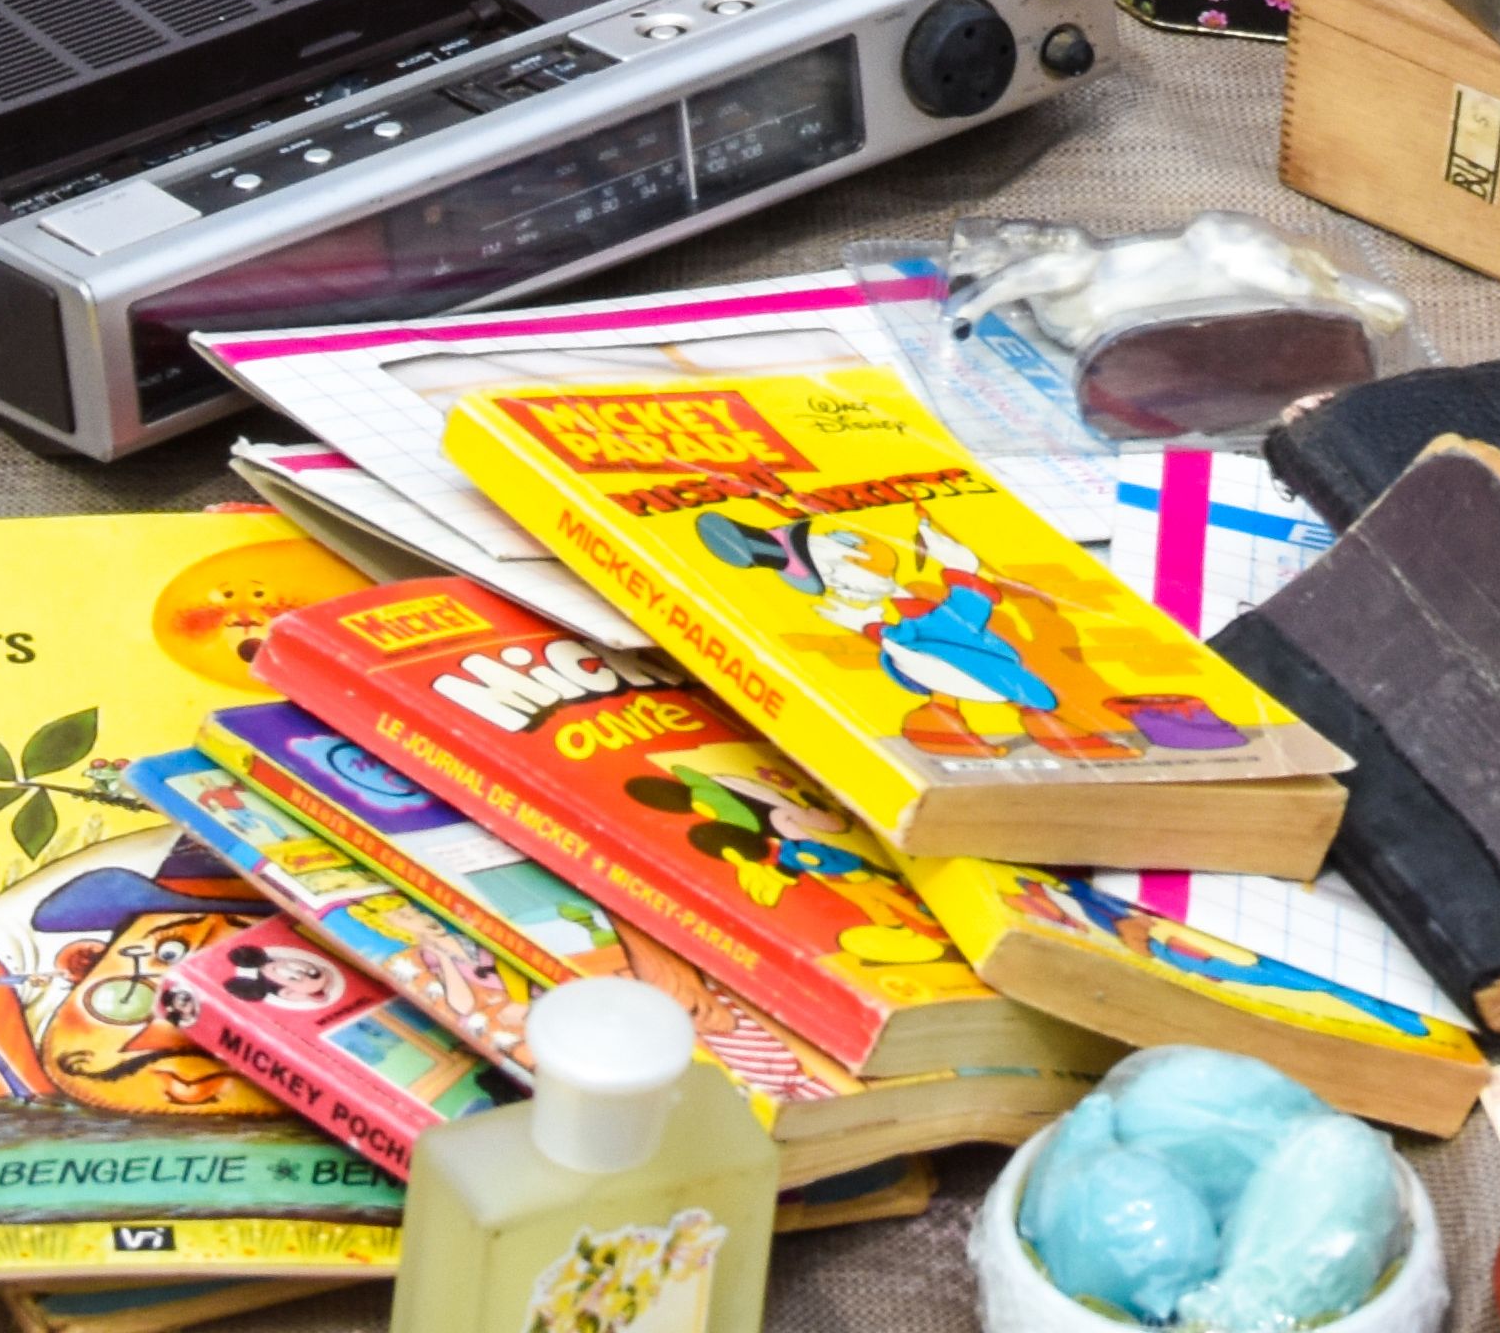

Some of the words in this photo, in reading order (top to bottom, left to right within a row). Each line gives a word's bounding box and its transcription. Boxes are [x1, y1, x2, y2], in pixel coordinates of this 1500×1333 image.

[526, 396, 736, 433] MICKEY
[561, 428, 786, 465] PARADE
[555, 695, 706, 761] ouvre
[402, 731, 486, 796] JOURNAL
[487, 783, 517, 815] DE
[513, 799, 590, 860] MICKEY
[219, 1028, 325, 1107] MICKEY
[332, 1101, 411, 1170] POCH
